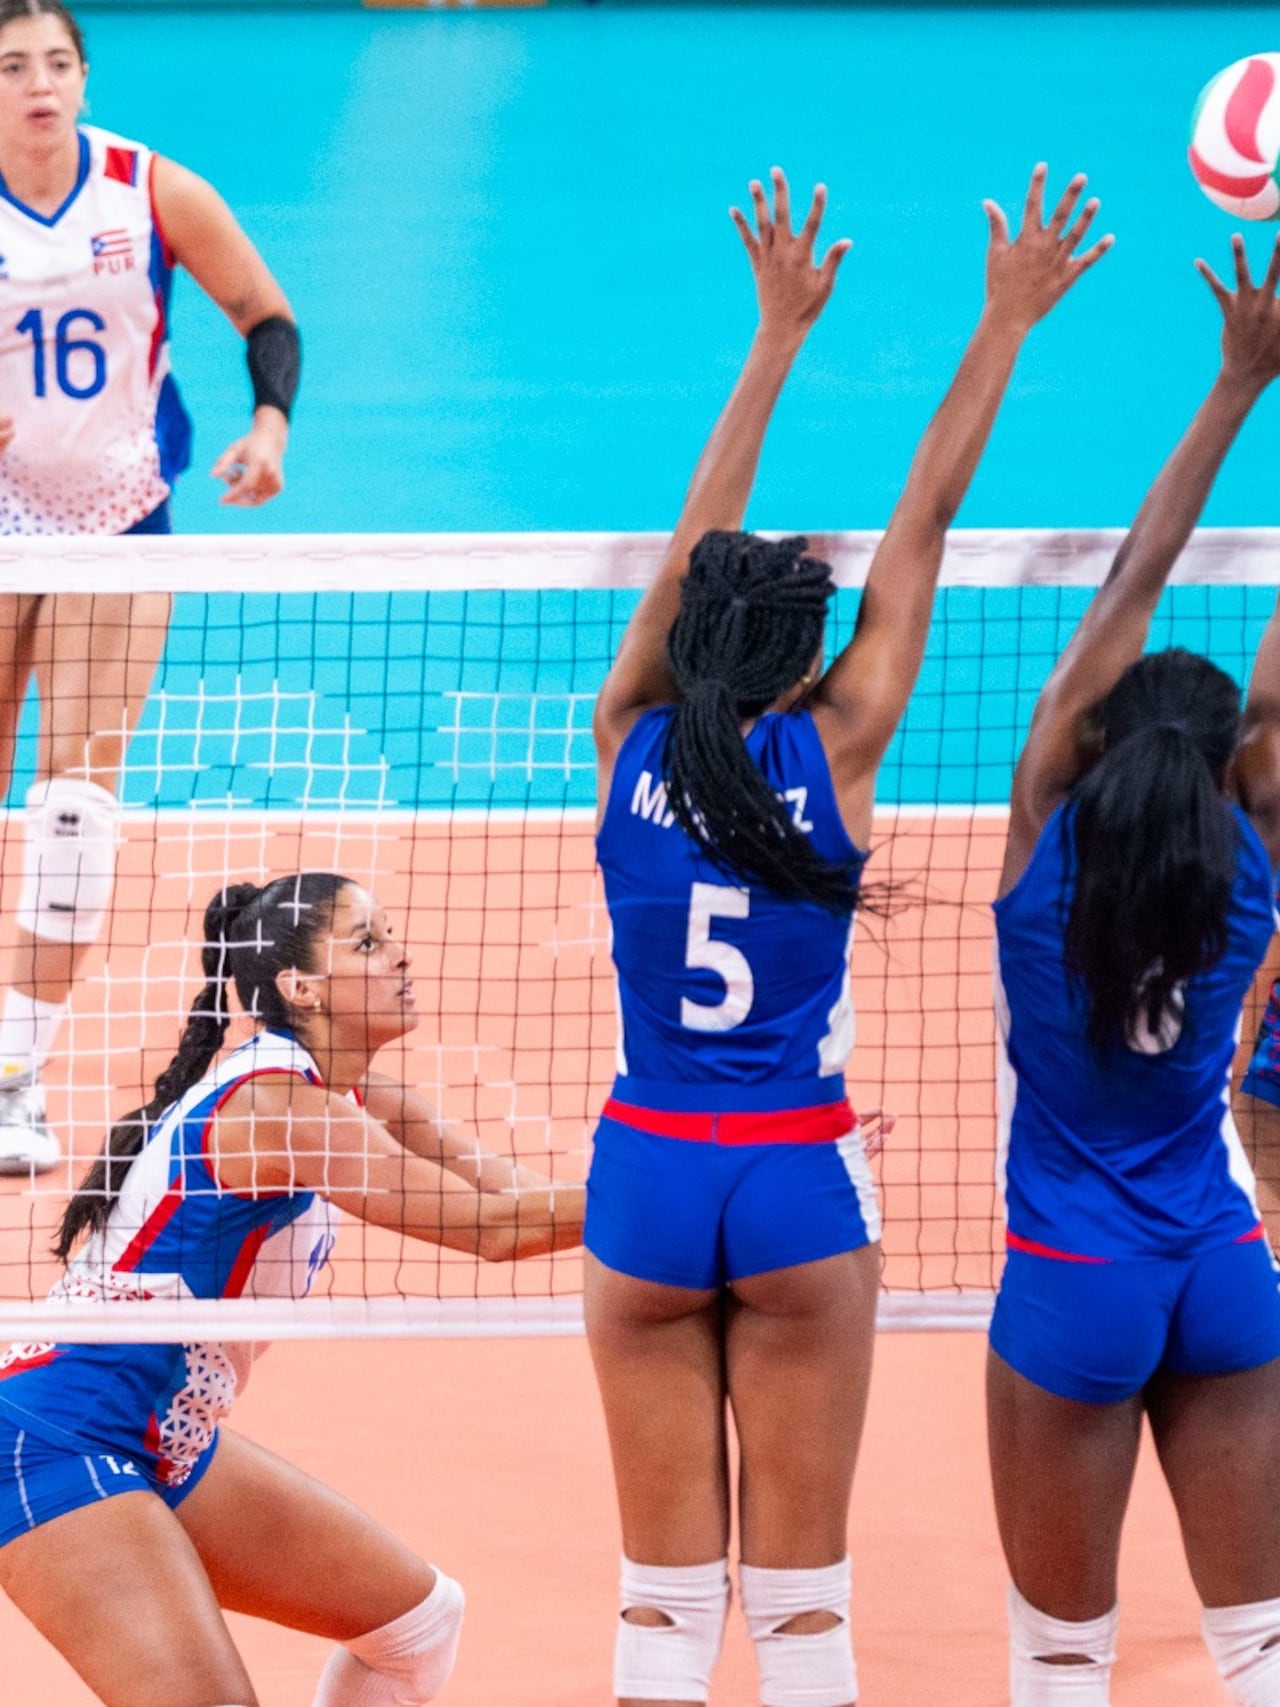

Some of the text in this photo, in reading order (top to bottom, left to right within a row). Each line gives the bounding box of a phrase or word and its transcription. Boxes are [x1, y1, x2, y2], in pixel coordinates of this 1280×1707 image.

[92, 256, 136, 276] PUR
[15, 308, 106, 400] 16
[680, 881, 755, 1032] 5
